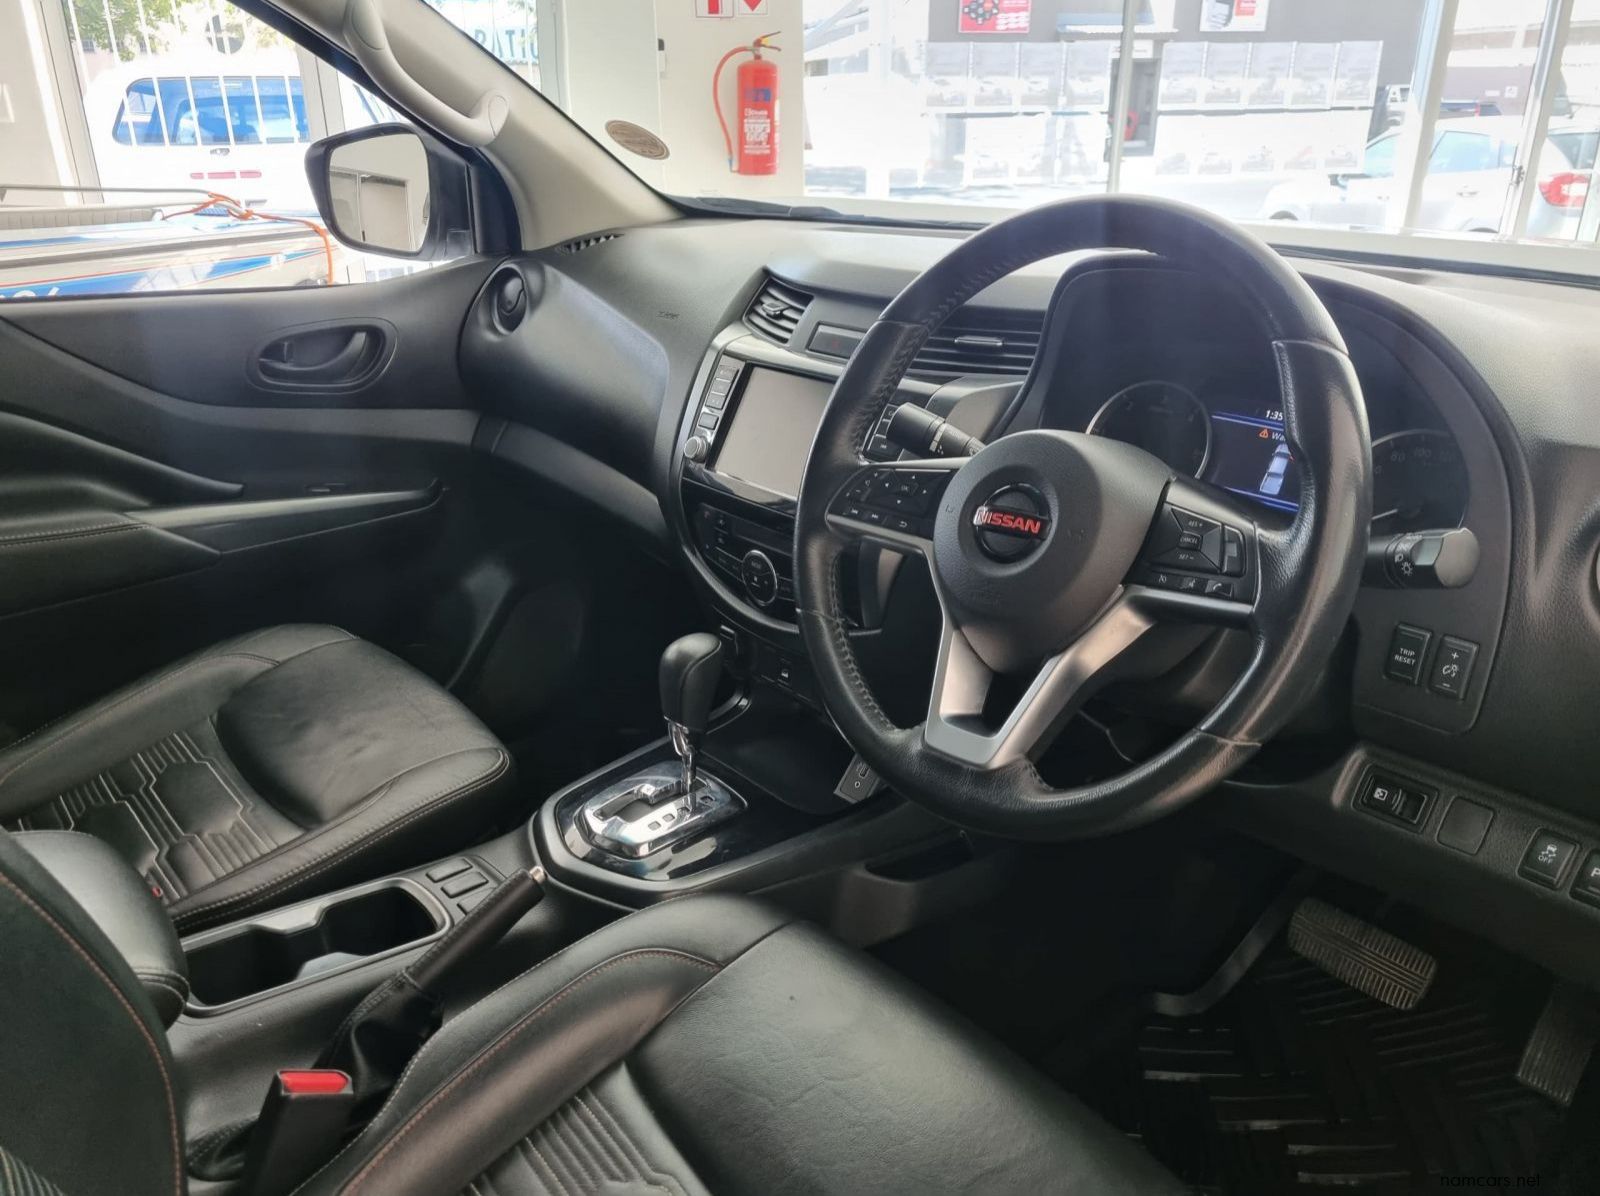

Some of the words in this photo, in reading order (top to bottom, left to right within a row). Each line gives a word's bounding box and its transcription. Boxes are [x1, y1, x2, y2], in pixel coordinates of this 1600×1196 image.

[1265, 409, 1284, 421] 1:35
[977, 510, 1041, 534] NISSAN
[1399, 647, 1416, 657] TRIP
[1393, 653, 1417, 666] RESET
